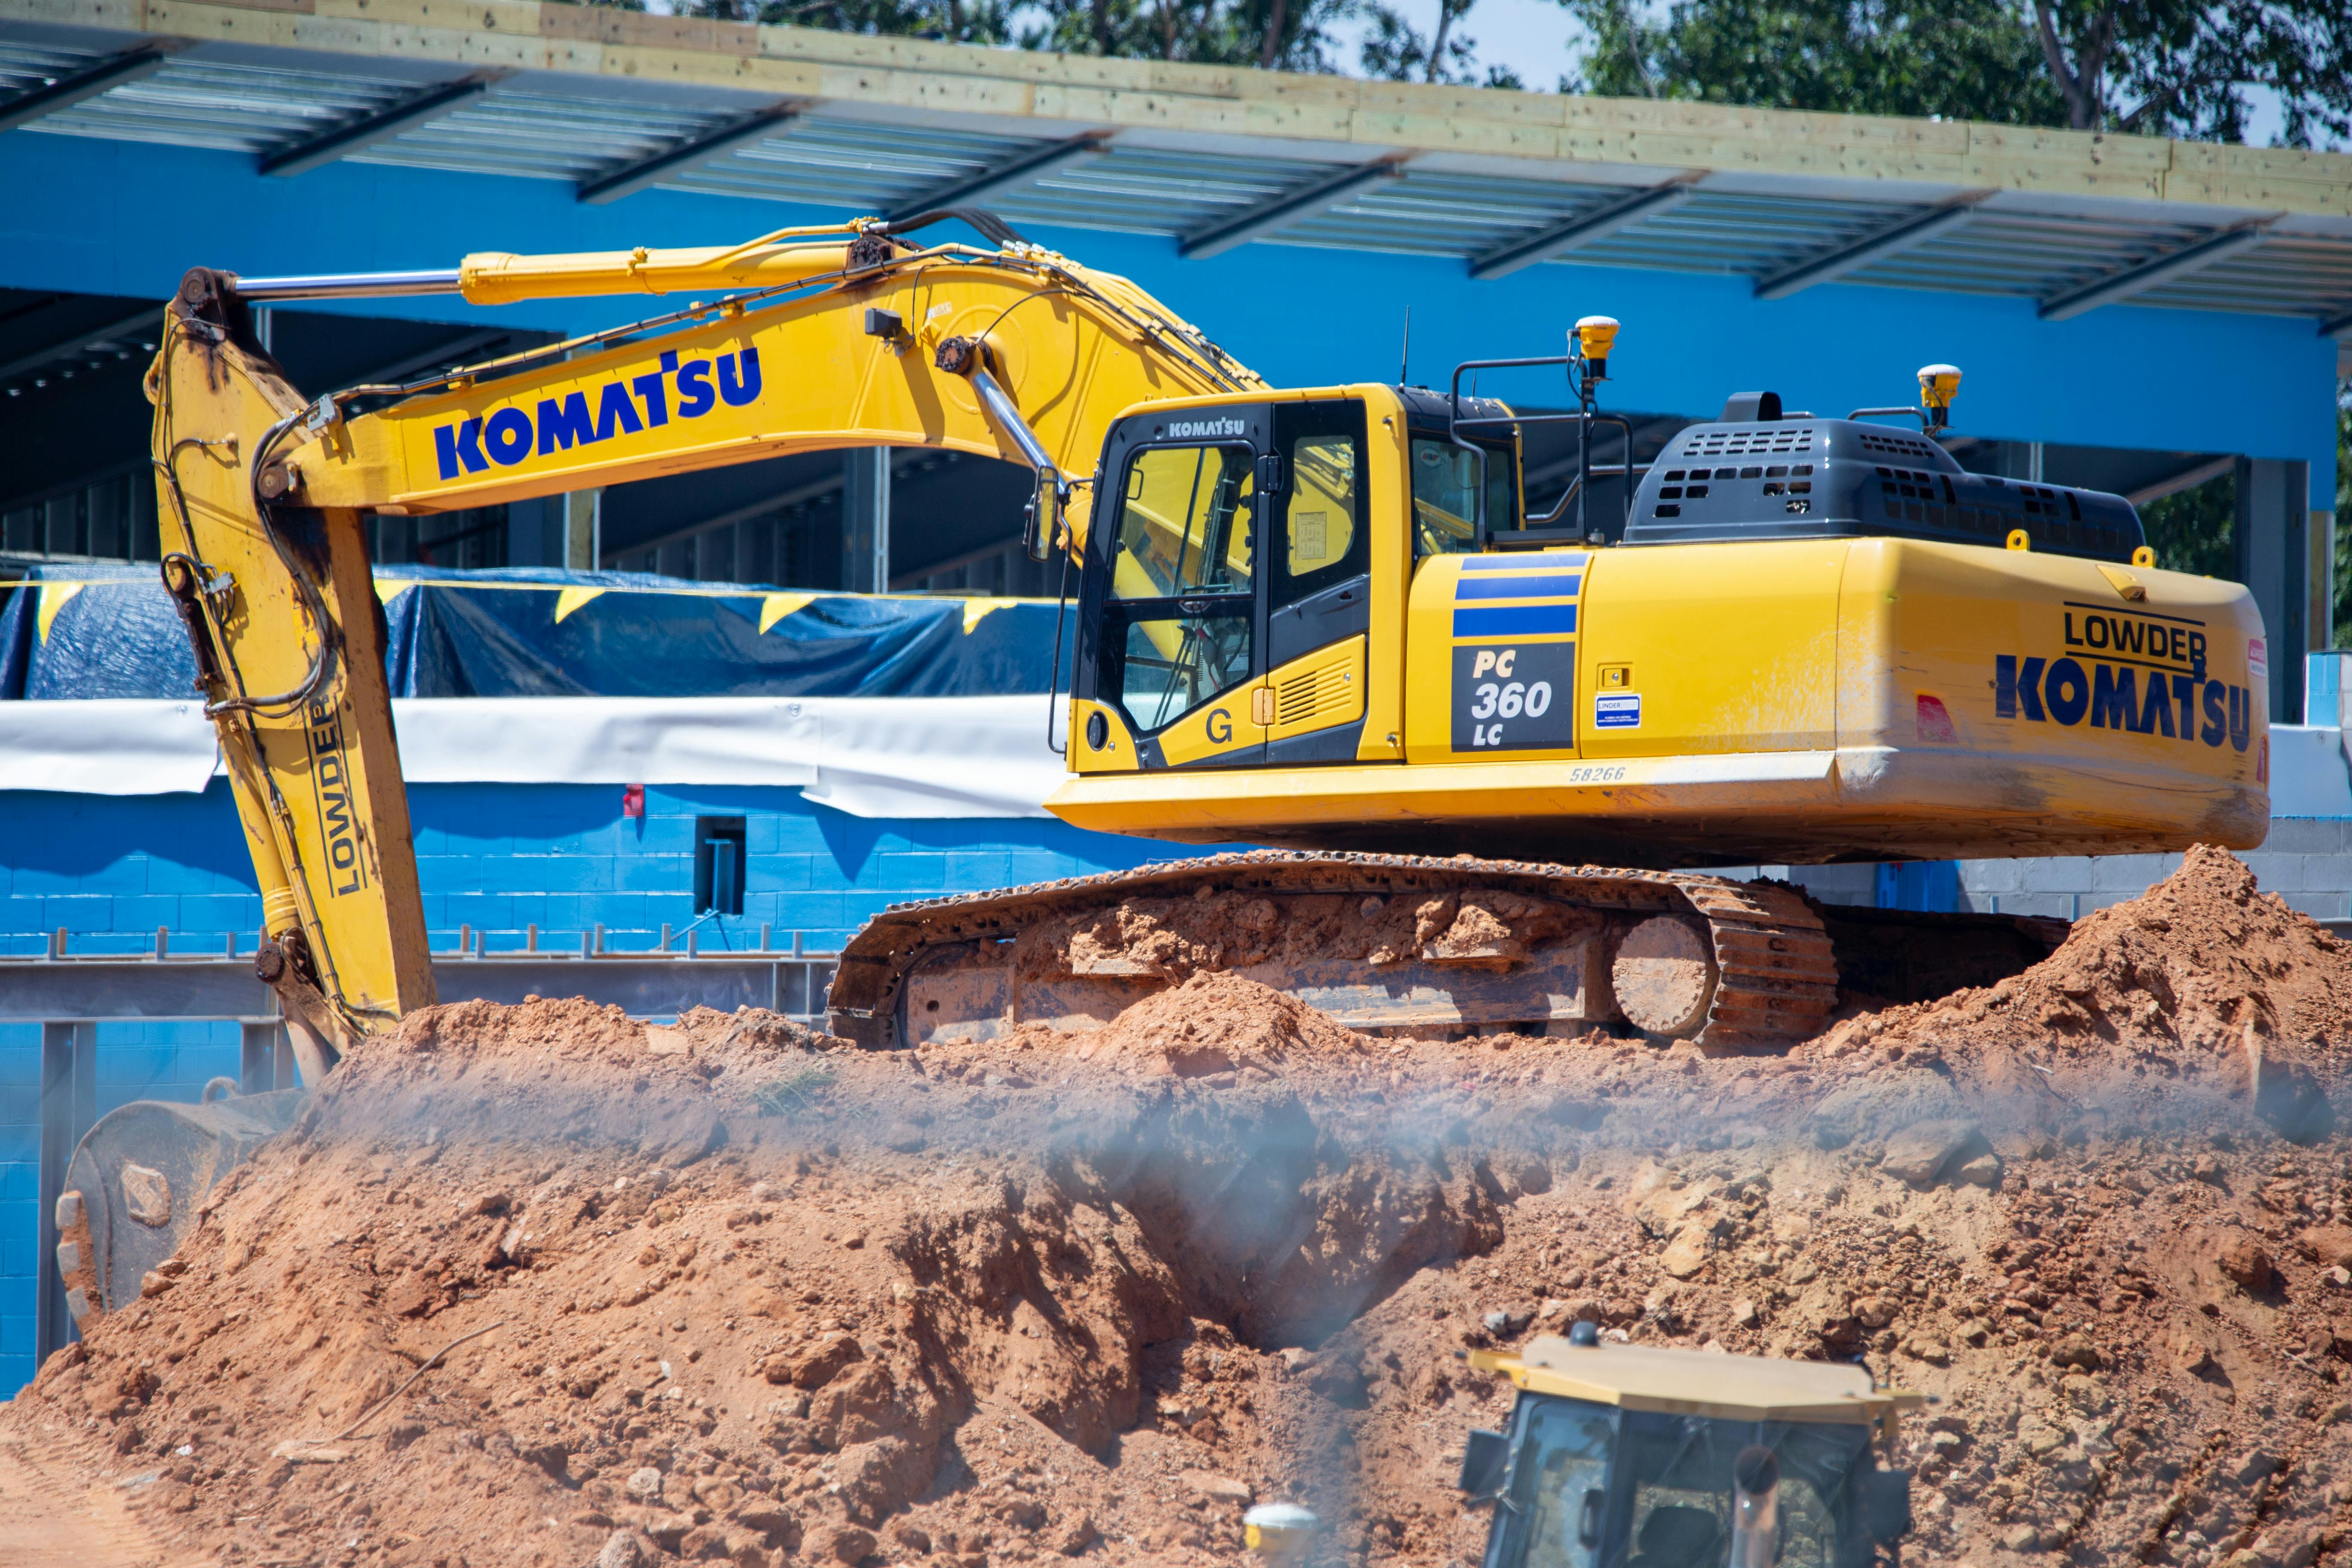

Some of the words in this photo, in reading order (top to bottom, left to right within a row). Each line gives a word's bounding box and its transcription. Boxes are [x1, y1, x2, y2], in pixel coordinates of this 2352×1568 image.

[434, 347, 762, 480] KOMATSU
[1169, 416, 1245, 438] KOMATSU
[2064, 612, 2206, 664] LOWDER
[1472, 650, 1516, 679] PC
[1471, 681, 1552, 720] 360
[1996, 655, 2250, 752] KOMATSU
[1206, 708, 1232, 744] G
[1473, 724, 1504, 746] LC
[1570, 767, 1626, 783] 58266
[309, 694, 360, 897] LOWDER
